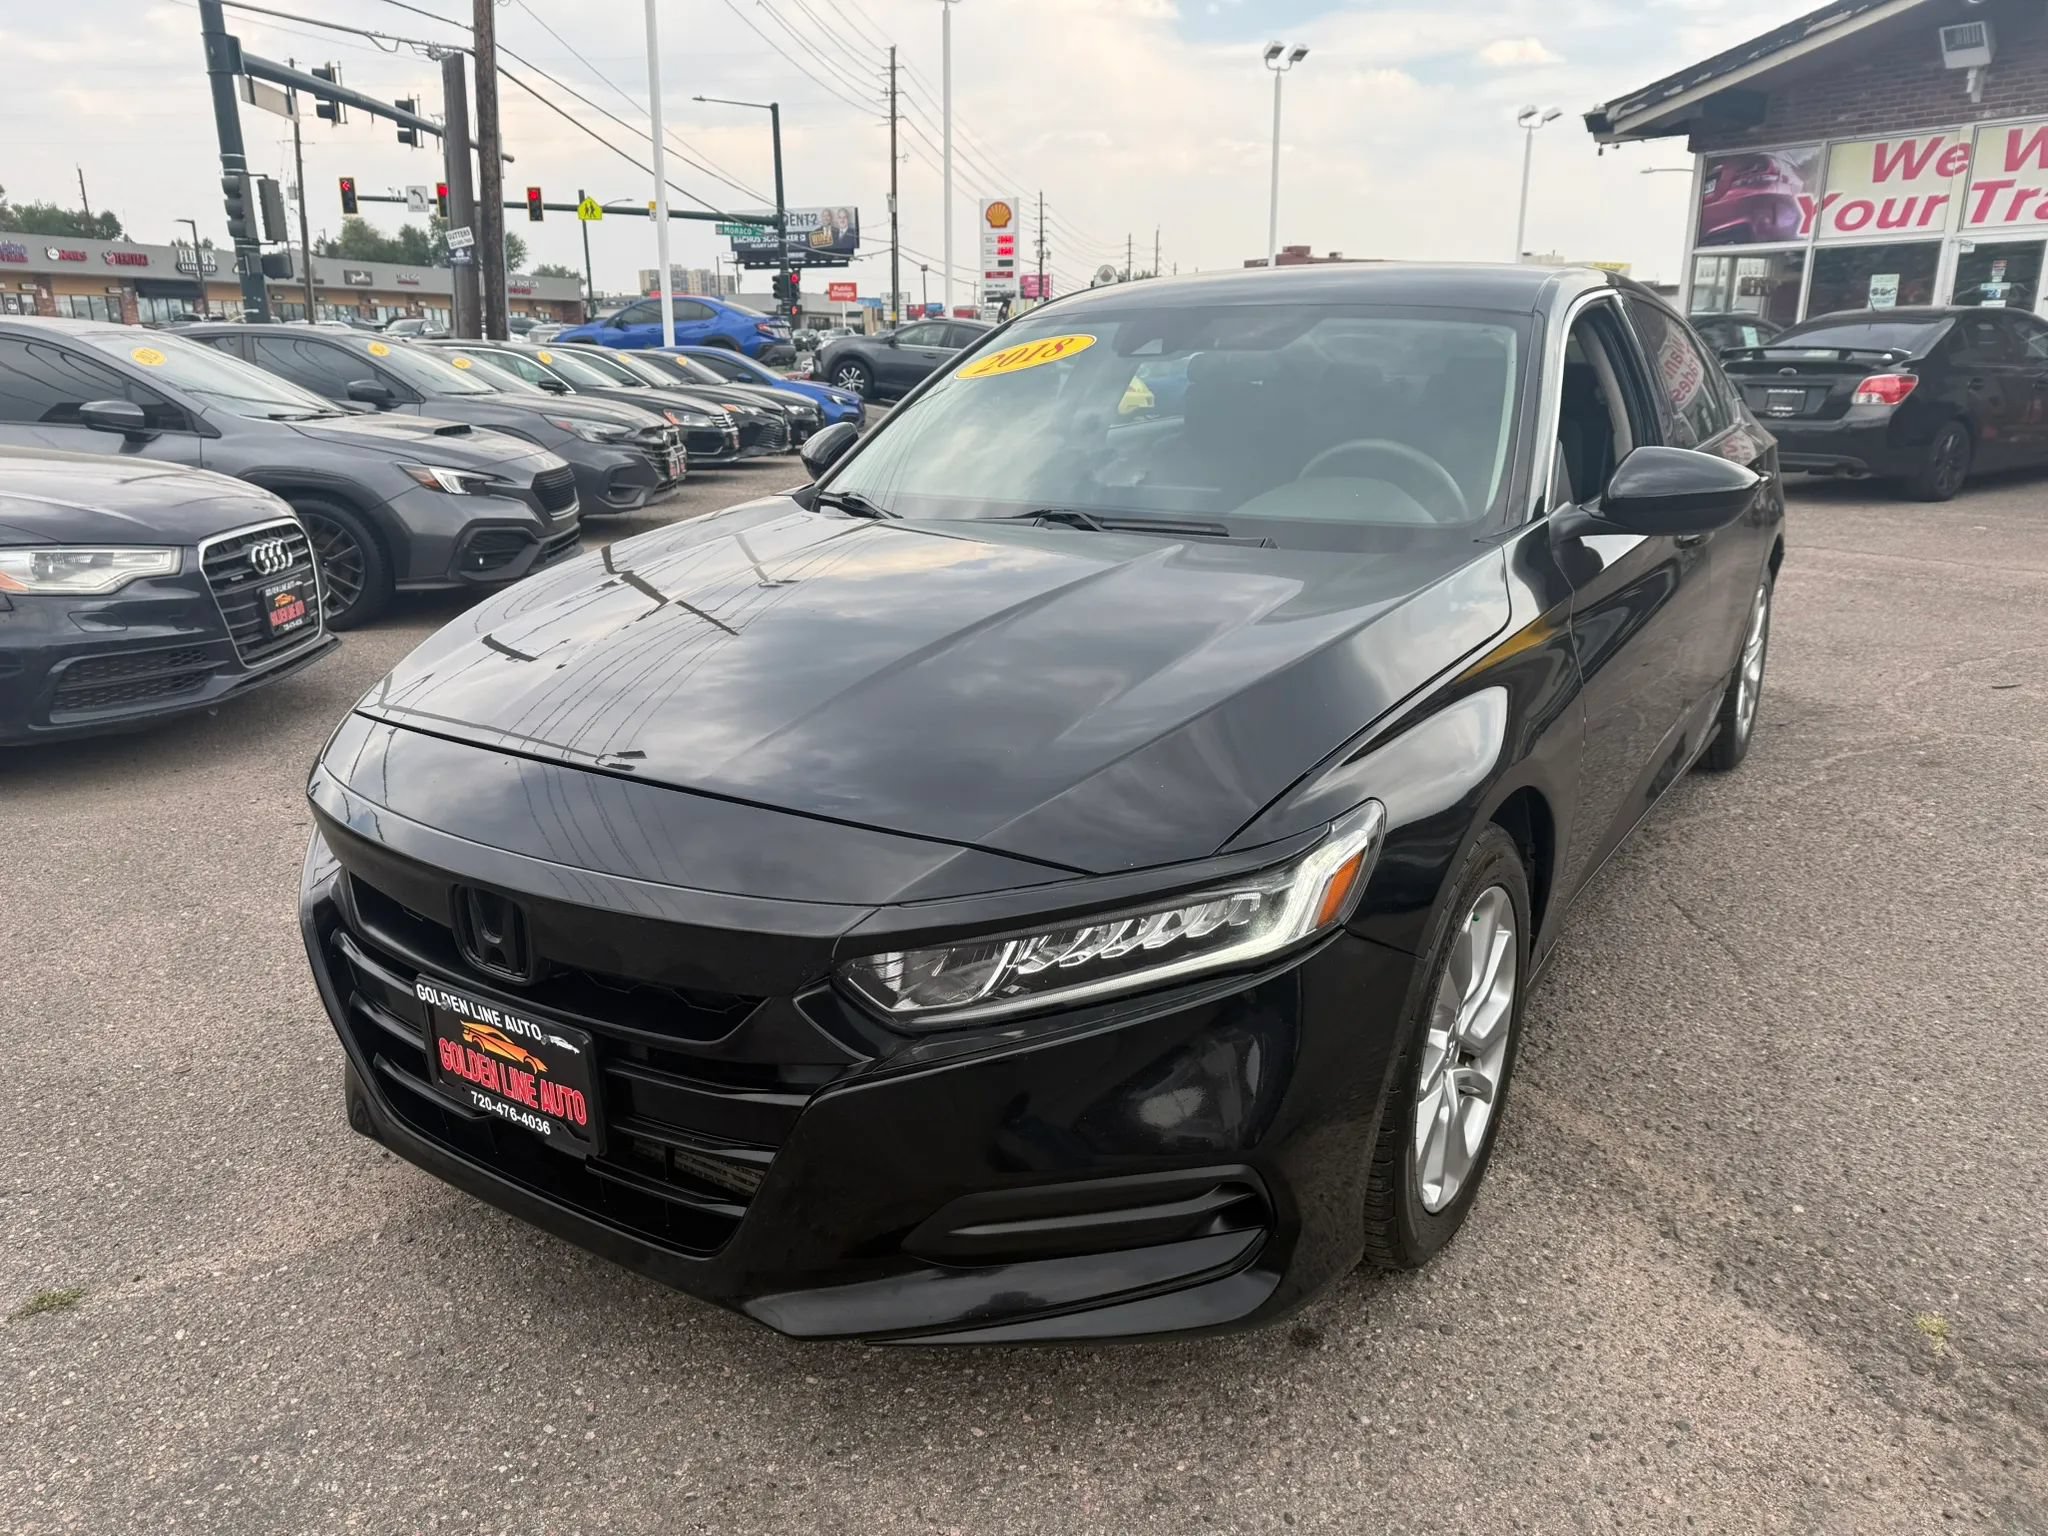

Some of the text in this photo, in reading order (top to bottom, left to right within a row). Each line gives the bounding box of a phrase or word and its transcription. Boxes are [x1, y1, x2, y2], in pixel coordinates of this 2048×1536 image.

[1872, 136, 1972, 183] We
[1796, 192, 1950, 234] Your
[972, 337, 1075, 375] 2018
[416, 983, 542, 1041] GOLDEN LINE AUTO
[438, 1037, 588, 1126] GOLDEN LINE AUTO
[471, 1090, 551, 1135] 720-476-4036
